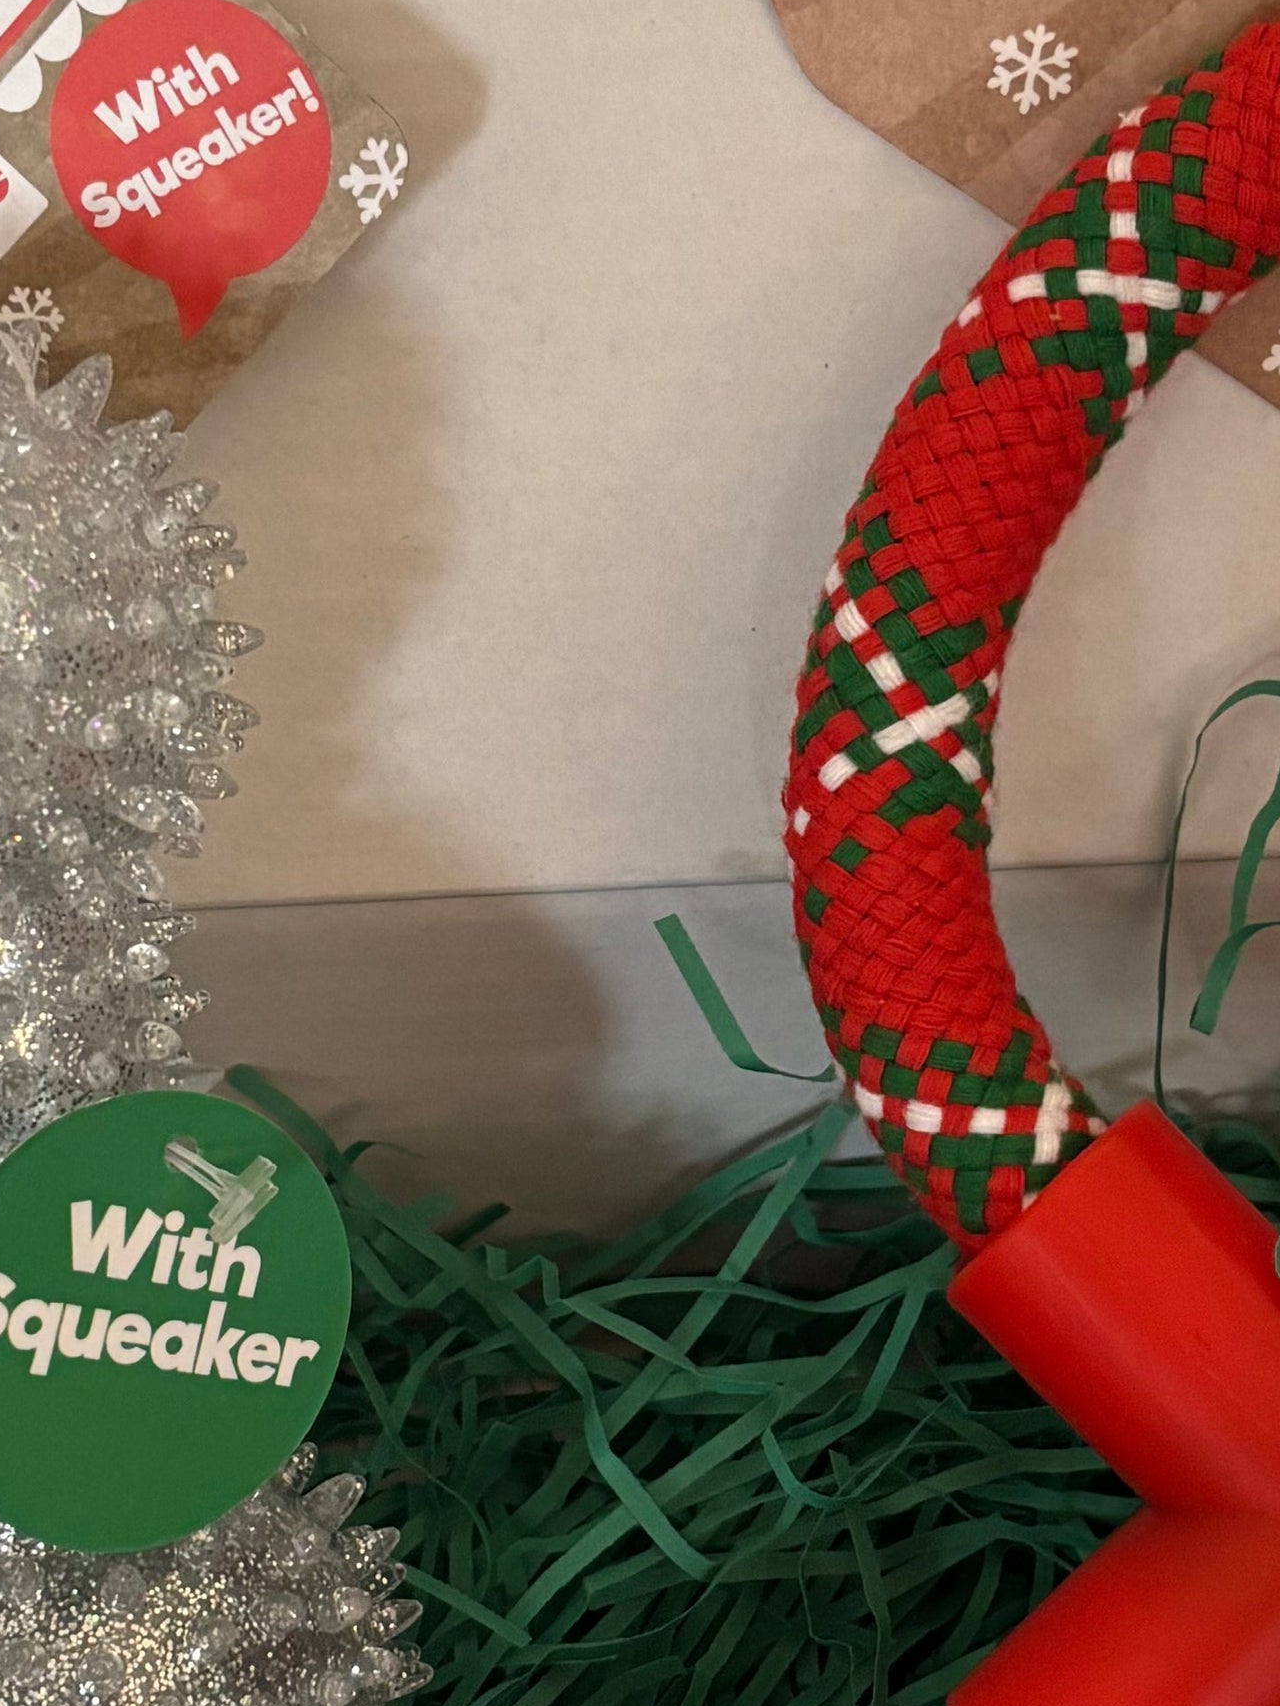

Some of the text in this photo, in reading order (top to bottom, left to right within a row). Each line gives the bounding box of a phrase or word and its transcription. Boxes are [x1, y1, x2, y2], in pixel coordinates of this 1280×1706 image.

[93, 45, 240, 145] With
[81, 67, 319, 228] Squeaker!
[71, 1200, 261, 1298] With
